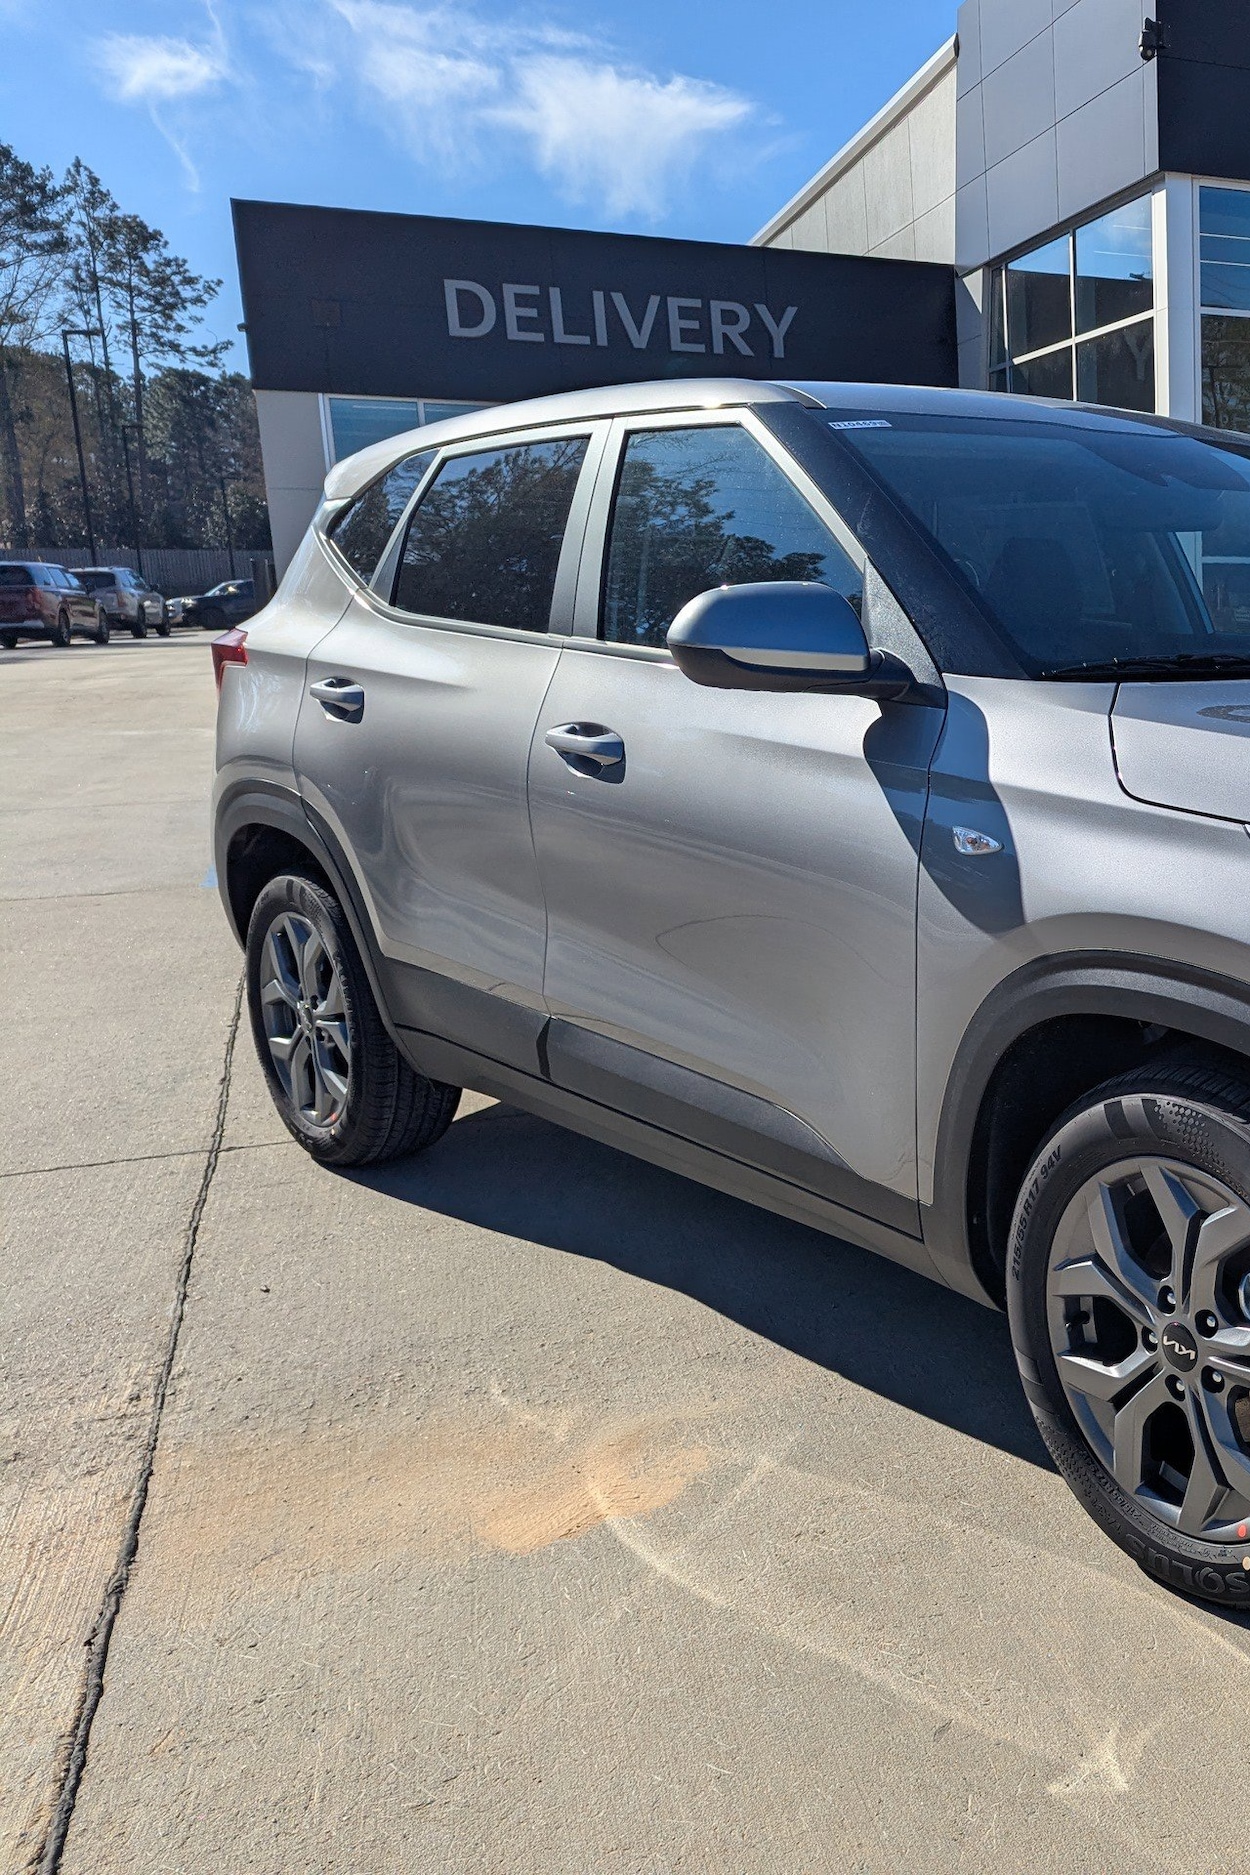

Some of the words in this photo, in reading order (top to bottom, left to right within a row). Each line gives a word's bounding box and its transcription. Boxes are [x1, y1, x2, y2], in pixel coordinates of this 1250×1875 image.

[443, 279, 798, 358] DELIVERY
[1040, 1144, 1062, 1180] 94V
[1125, 1532, 1250, 1594] SOLUS
